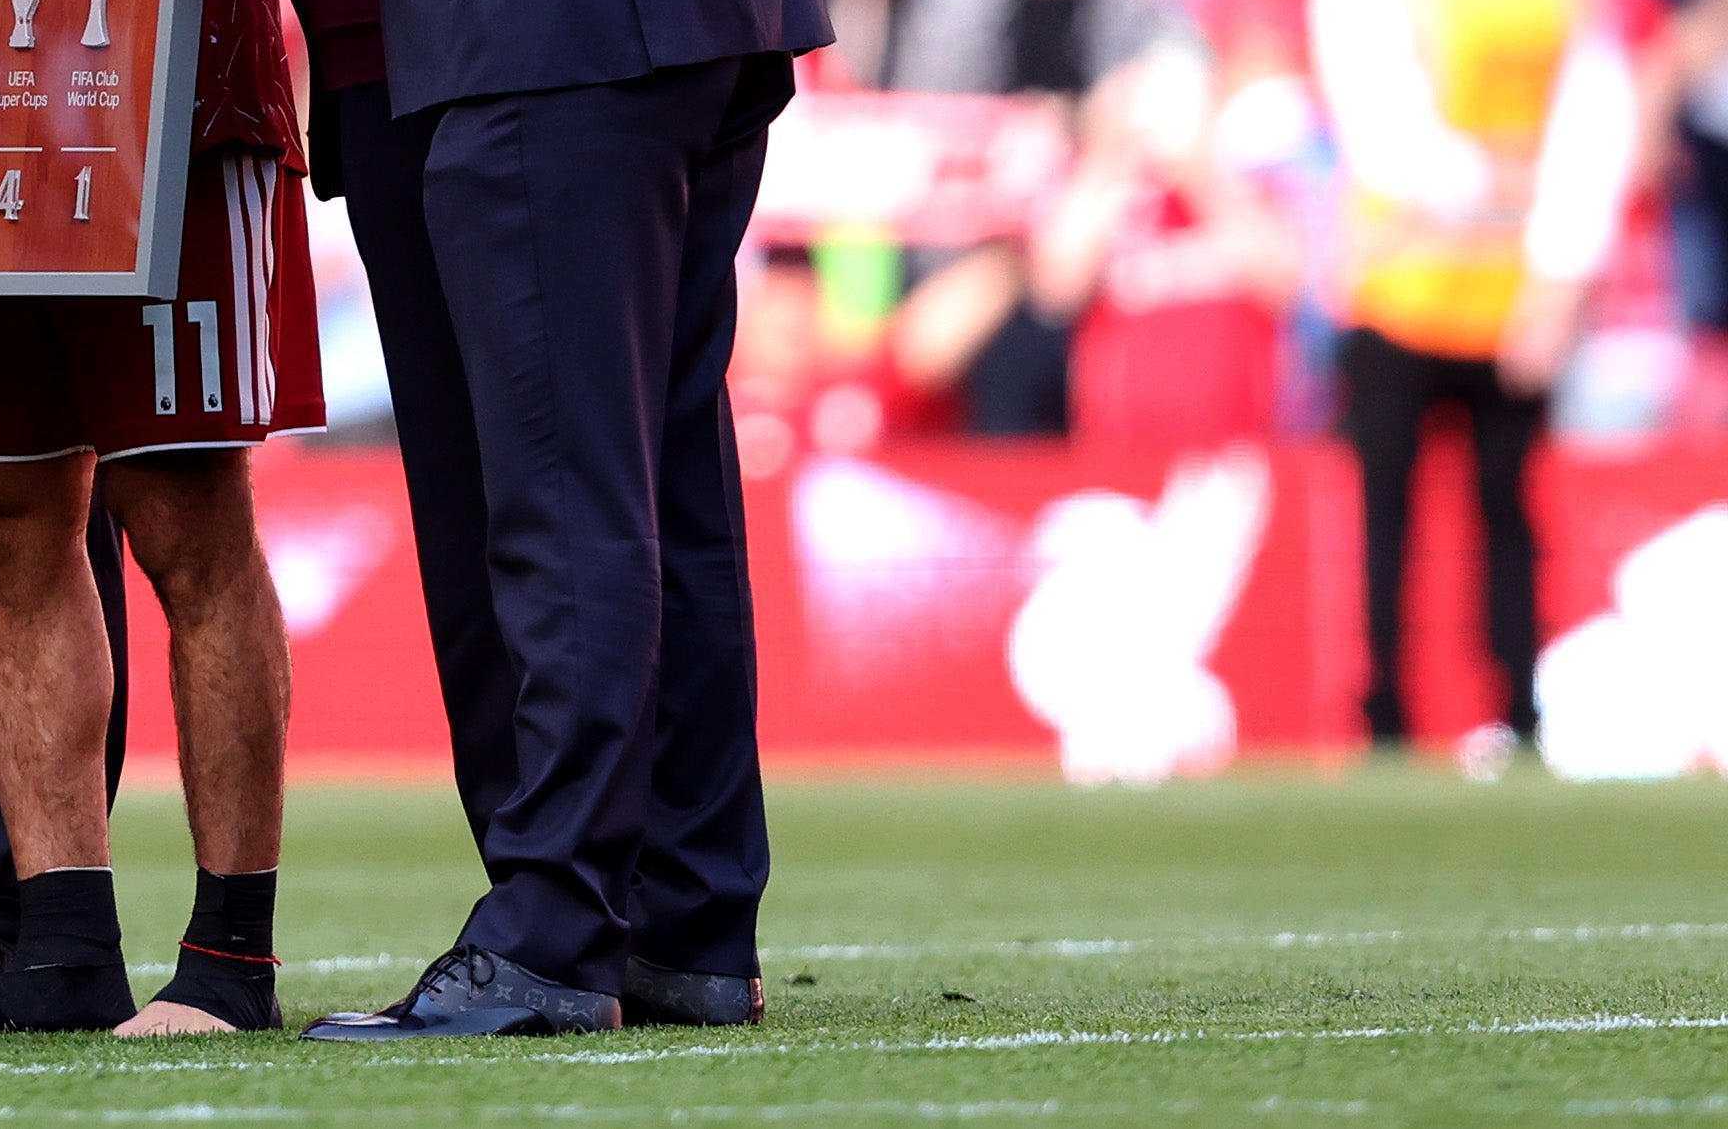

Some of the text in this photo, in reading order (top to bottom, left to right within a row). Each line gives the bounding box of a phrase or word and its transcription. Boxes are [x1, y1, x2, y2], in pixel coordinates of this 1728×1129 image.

[8, 71, 34, 86] UEFA
[71, 70, 118, 86] FIFA Club
[22, 91, 47, 109] Cups
[67, 91, 119, 109] World Cup
[73, 165, 92, 220] 1
[142, 300, 223, 415] 11
